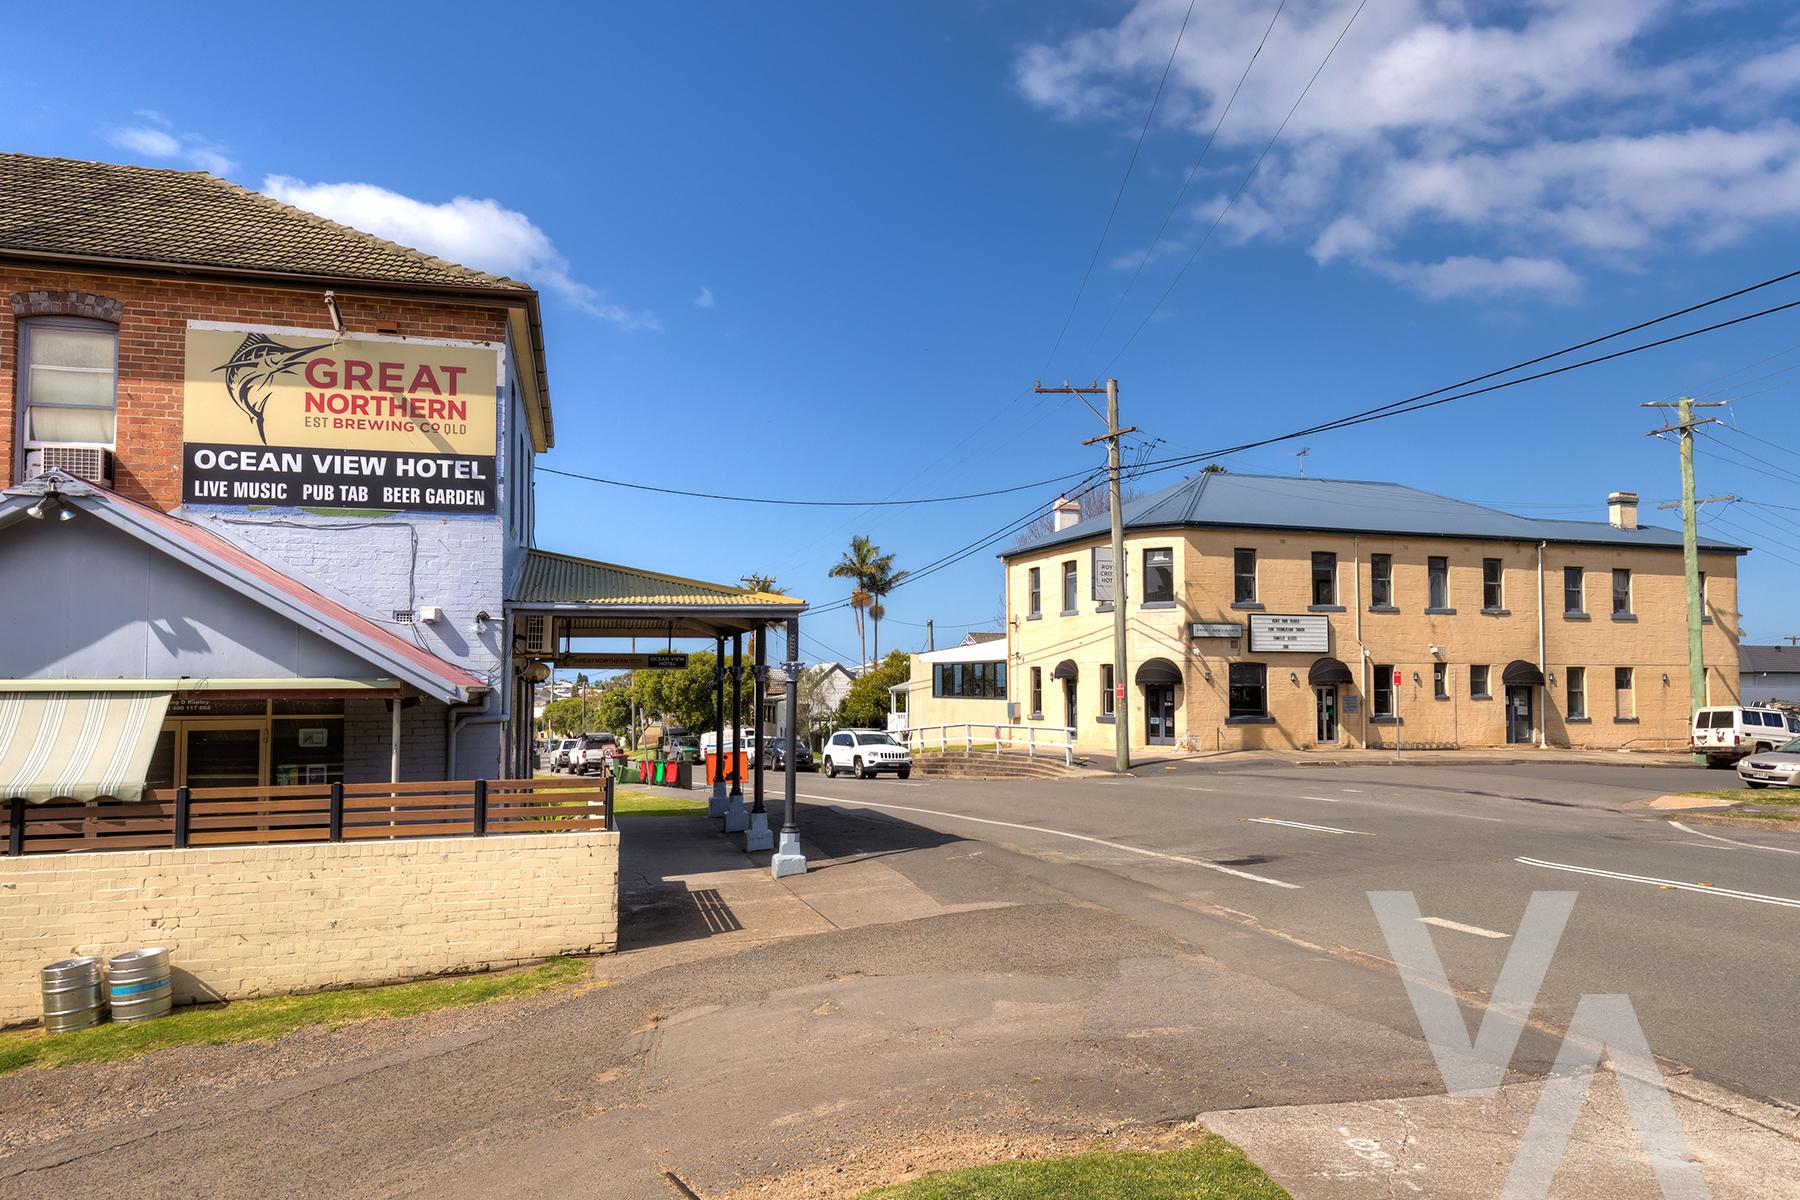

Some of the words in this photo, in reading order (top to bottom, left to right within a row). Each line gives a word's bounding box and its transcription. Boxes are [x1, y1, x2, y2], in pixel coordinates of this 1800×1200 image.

[304, 357, 467, 396] GREAT
[304, 392, 467, 421] NORTHERN
[304, 416, 329, 429] EST
[333, 418, 415, 433] BREWING
[444, 423, 467, 435] QLD
[194, 449, 302, 473] OCEAN
[312, 454, 387, 476] VIEW
[396, 458, 487, 480] HOTEL
[194, 480, 228, 498] LIVE
[233, 481, 288, 500] MUSIC
[302, 484, 334, 501] PUB
[339, 485, 368, 502] TAB
[383, 488, 420, 504] BEER
[425, 489, 485, 506] GARDEN
